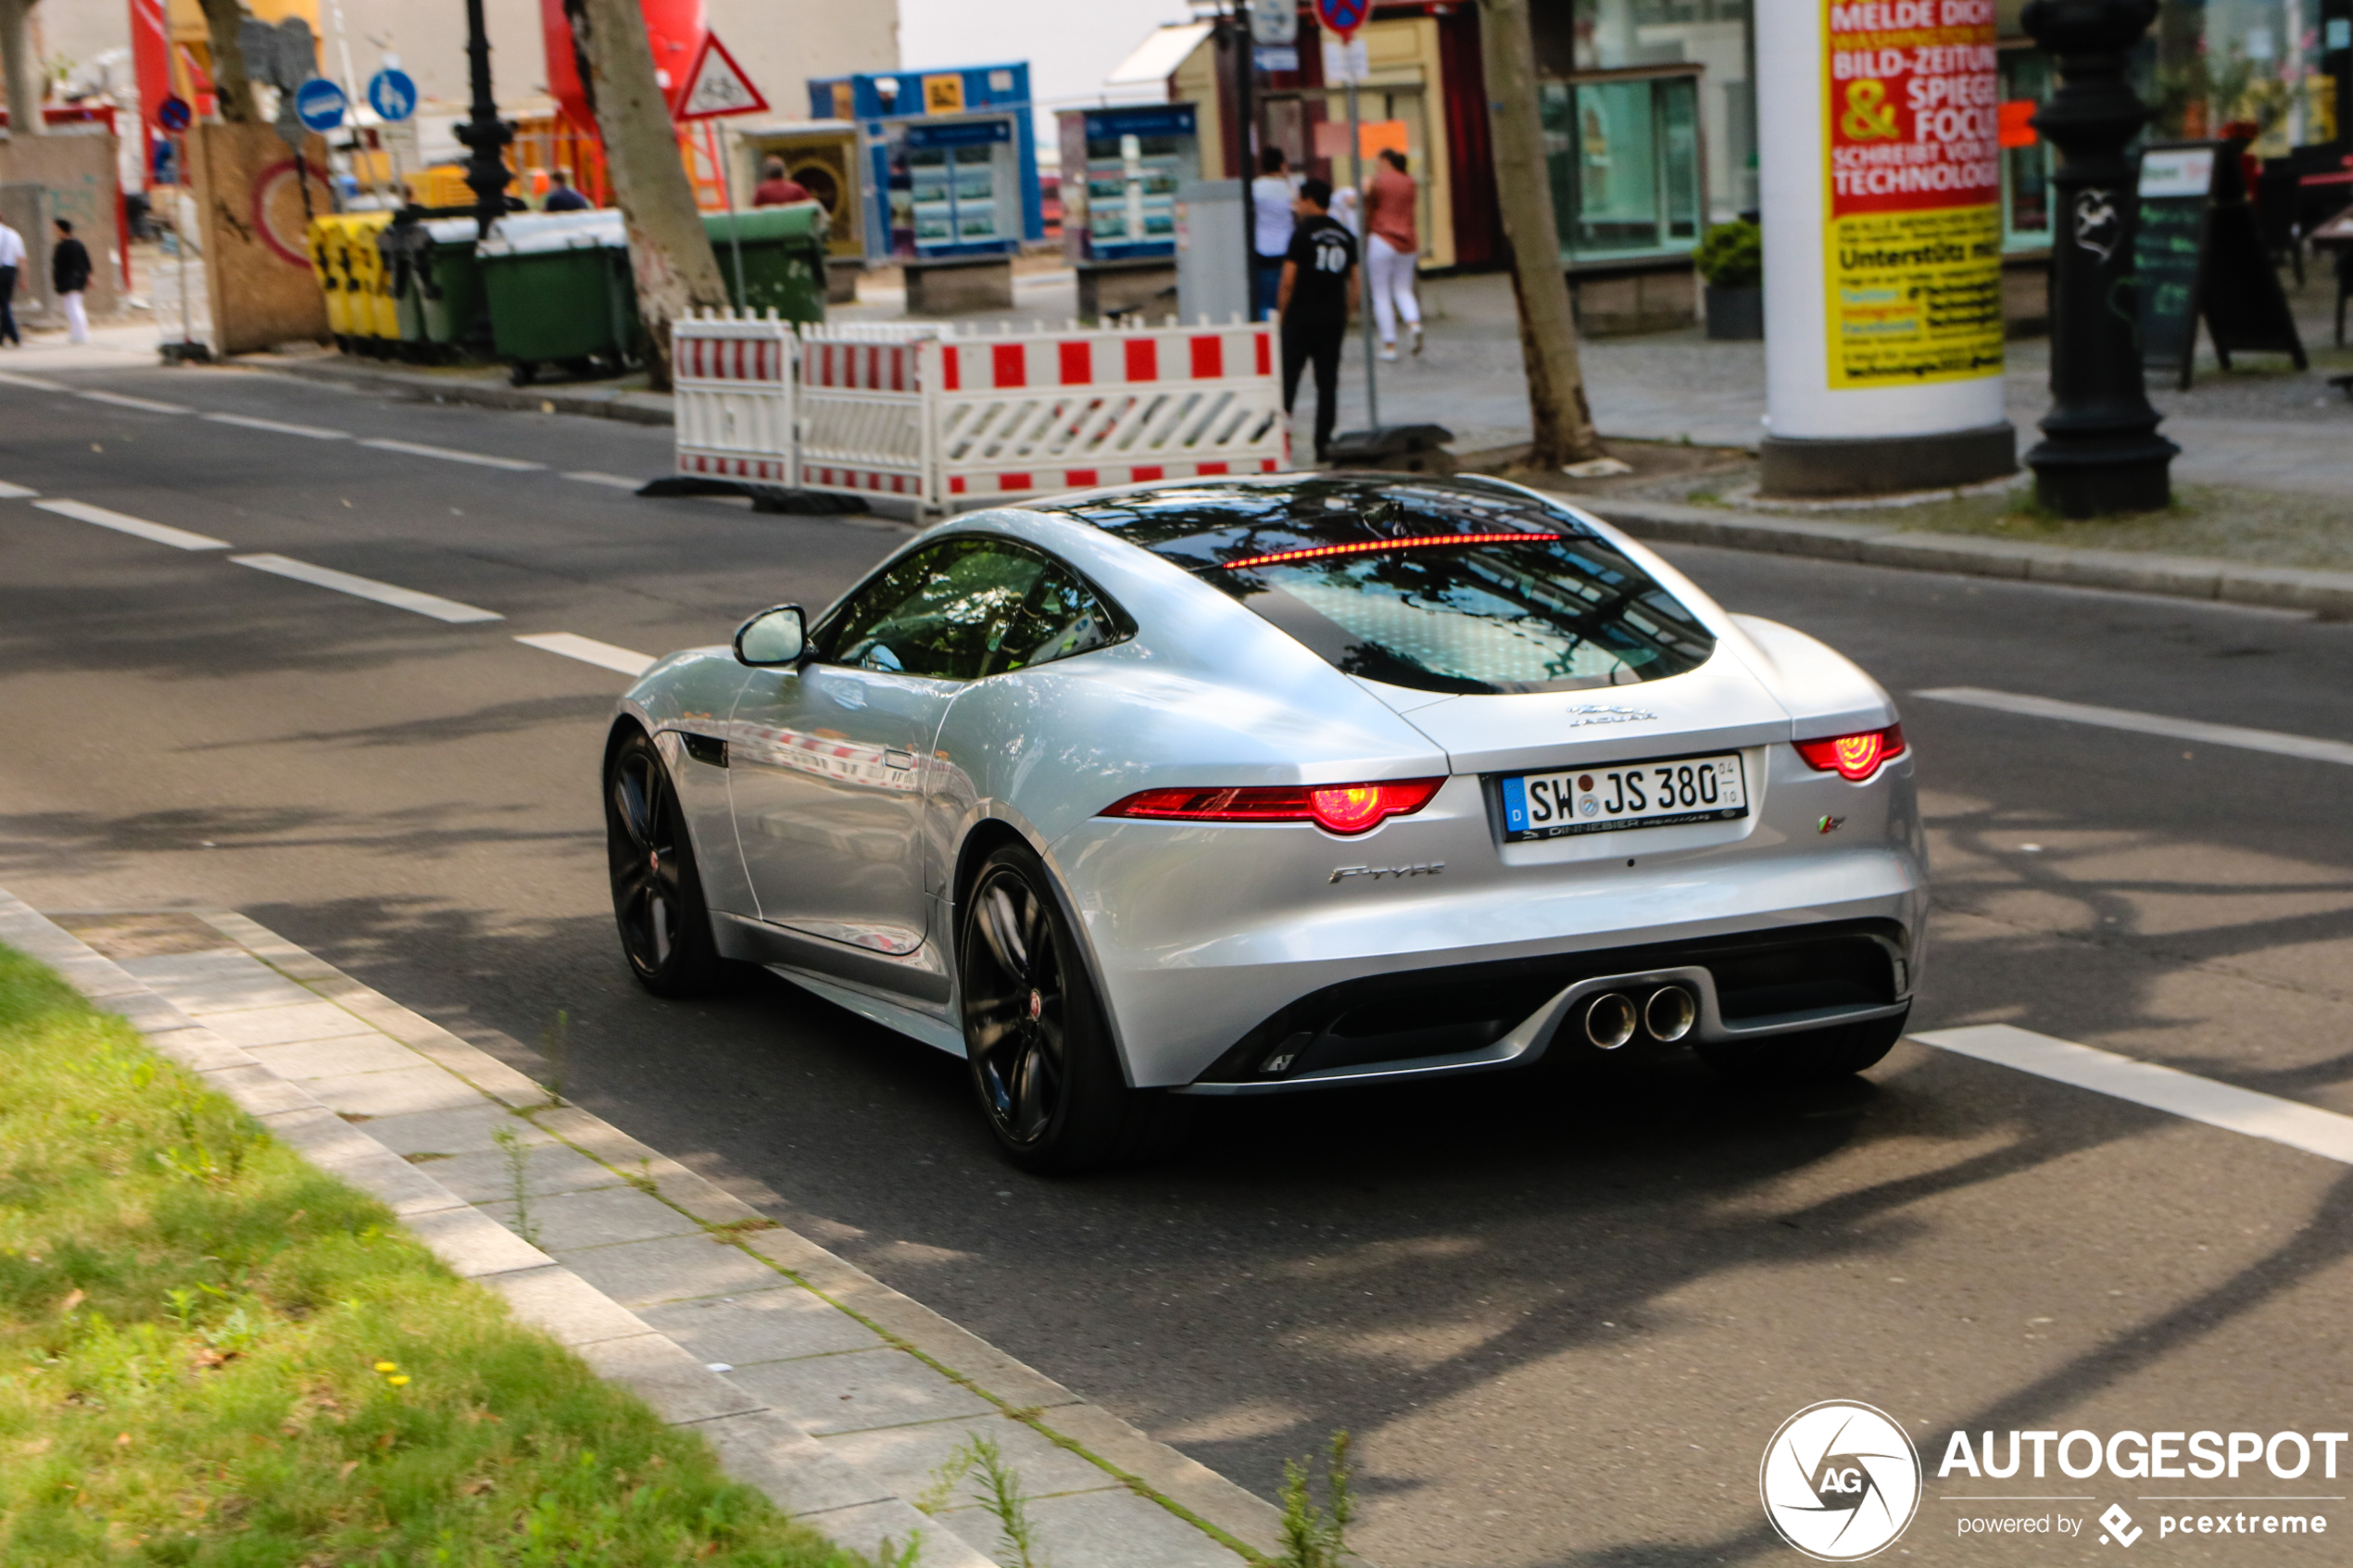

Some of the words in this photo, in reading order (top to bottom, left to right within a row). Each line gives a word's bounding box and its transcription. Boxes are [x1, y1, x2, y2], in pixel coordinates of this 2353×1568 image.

[1831, 3, 1936, 32] MELDE
[1841, 78, 1899, 141] &
[1316, 245, 1347, 273] 10
[1719, 761, 1734, 775] 04
[1512, 809, 1522, 822] D
[1530, 777, 1574, 822] SW
[1604, 771, 1648, 814] JS
[1655, 763, 1718, 809] 380
[1722, 790, 1737, 804] 10
[1549, 817, 1640, 837] DINNEBIER
[1328, 863, 1445, 884] F-TYPE
